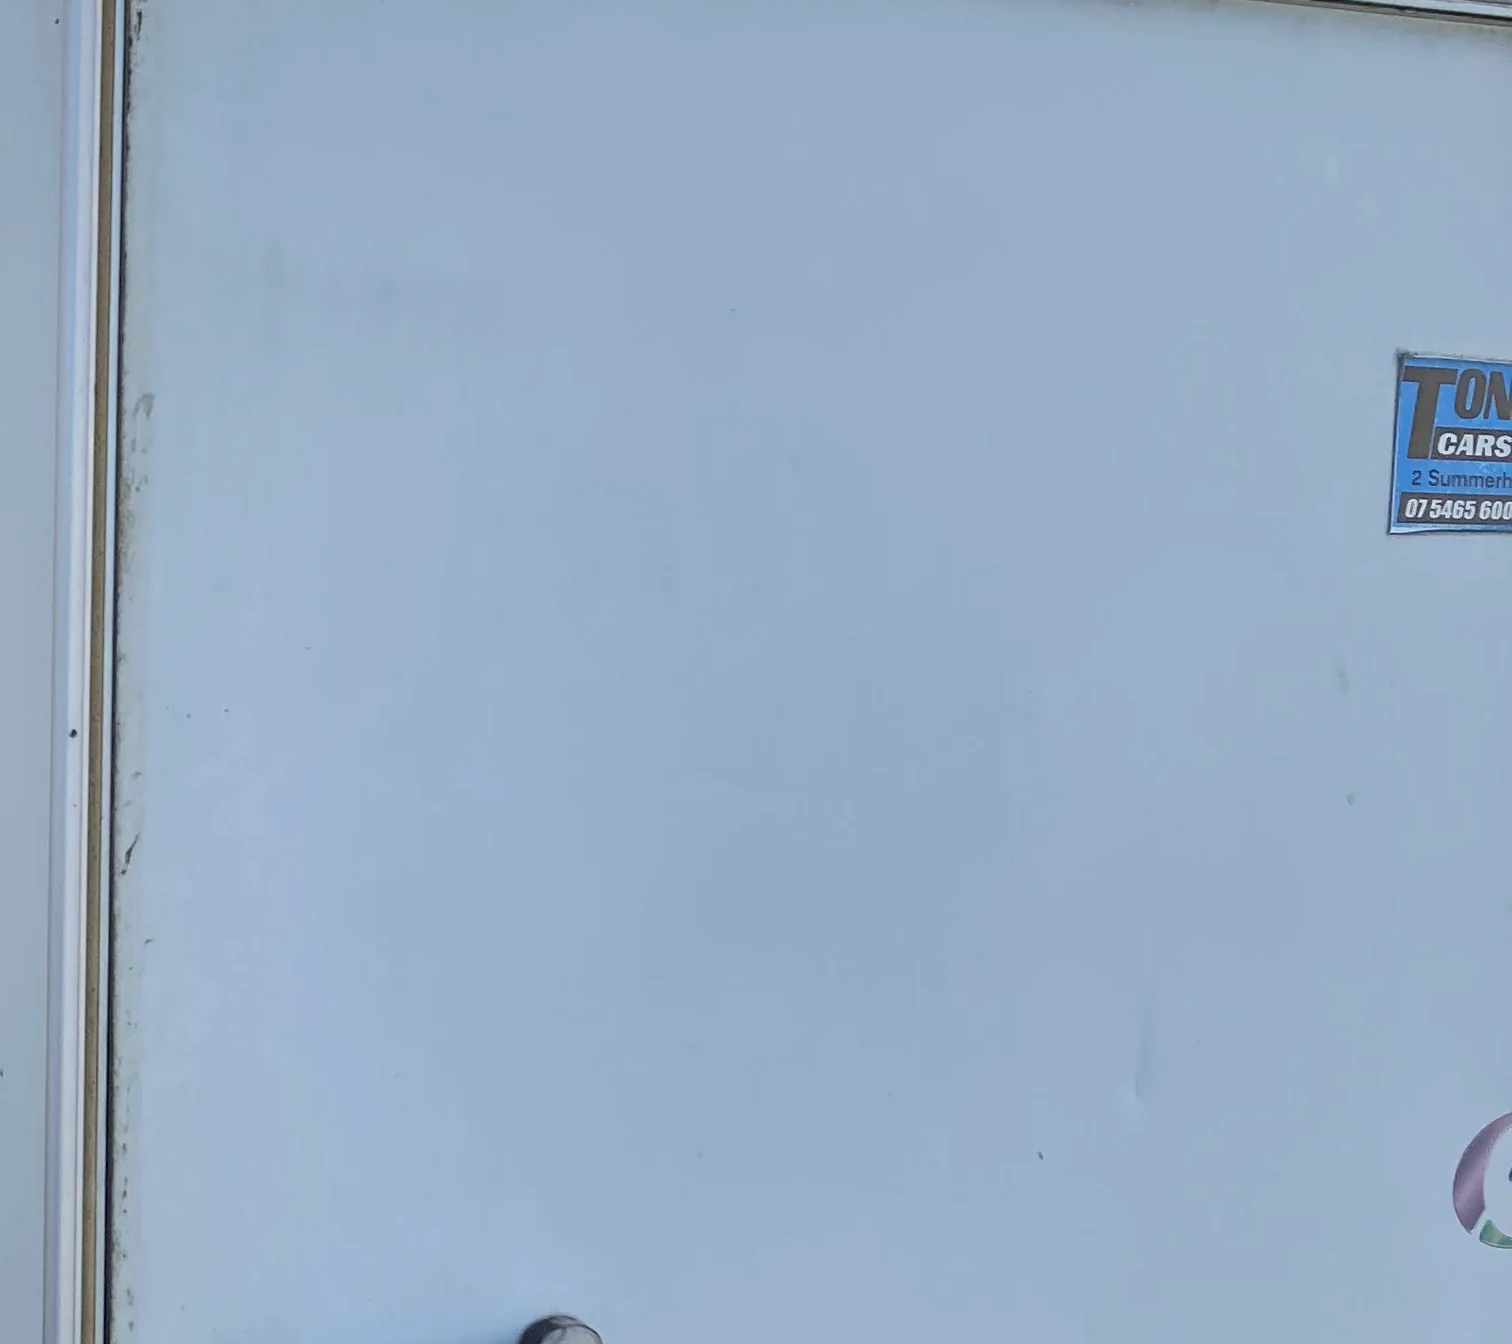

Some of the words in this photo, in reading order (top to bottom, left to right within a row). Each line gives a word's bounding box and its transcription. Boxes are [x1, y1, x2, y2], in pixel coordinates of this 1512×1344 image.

[1437, 432, 1512, 458] CARS
[1411, 469, 1423, 487] 2
[1405, 498, 1429, 519] 07
[1429, 499, 1477, 520] 5465
